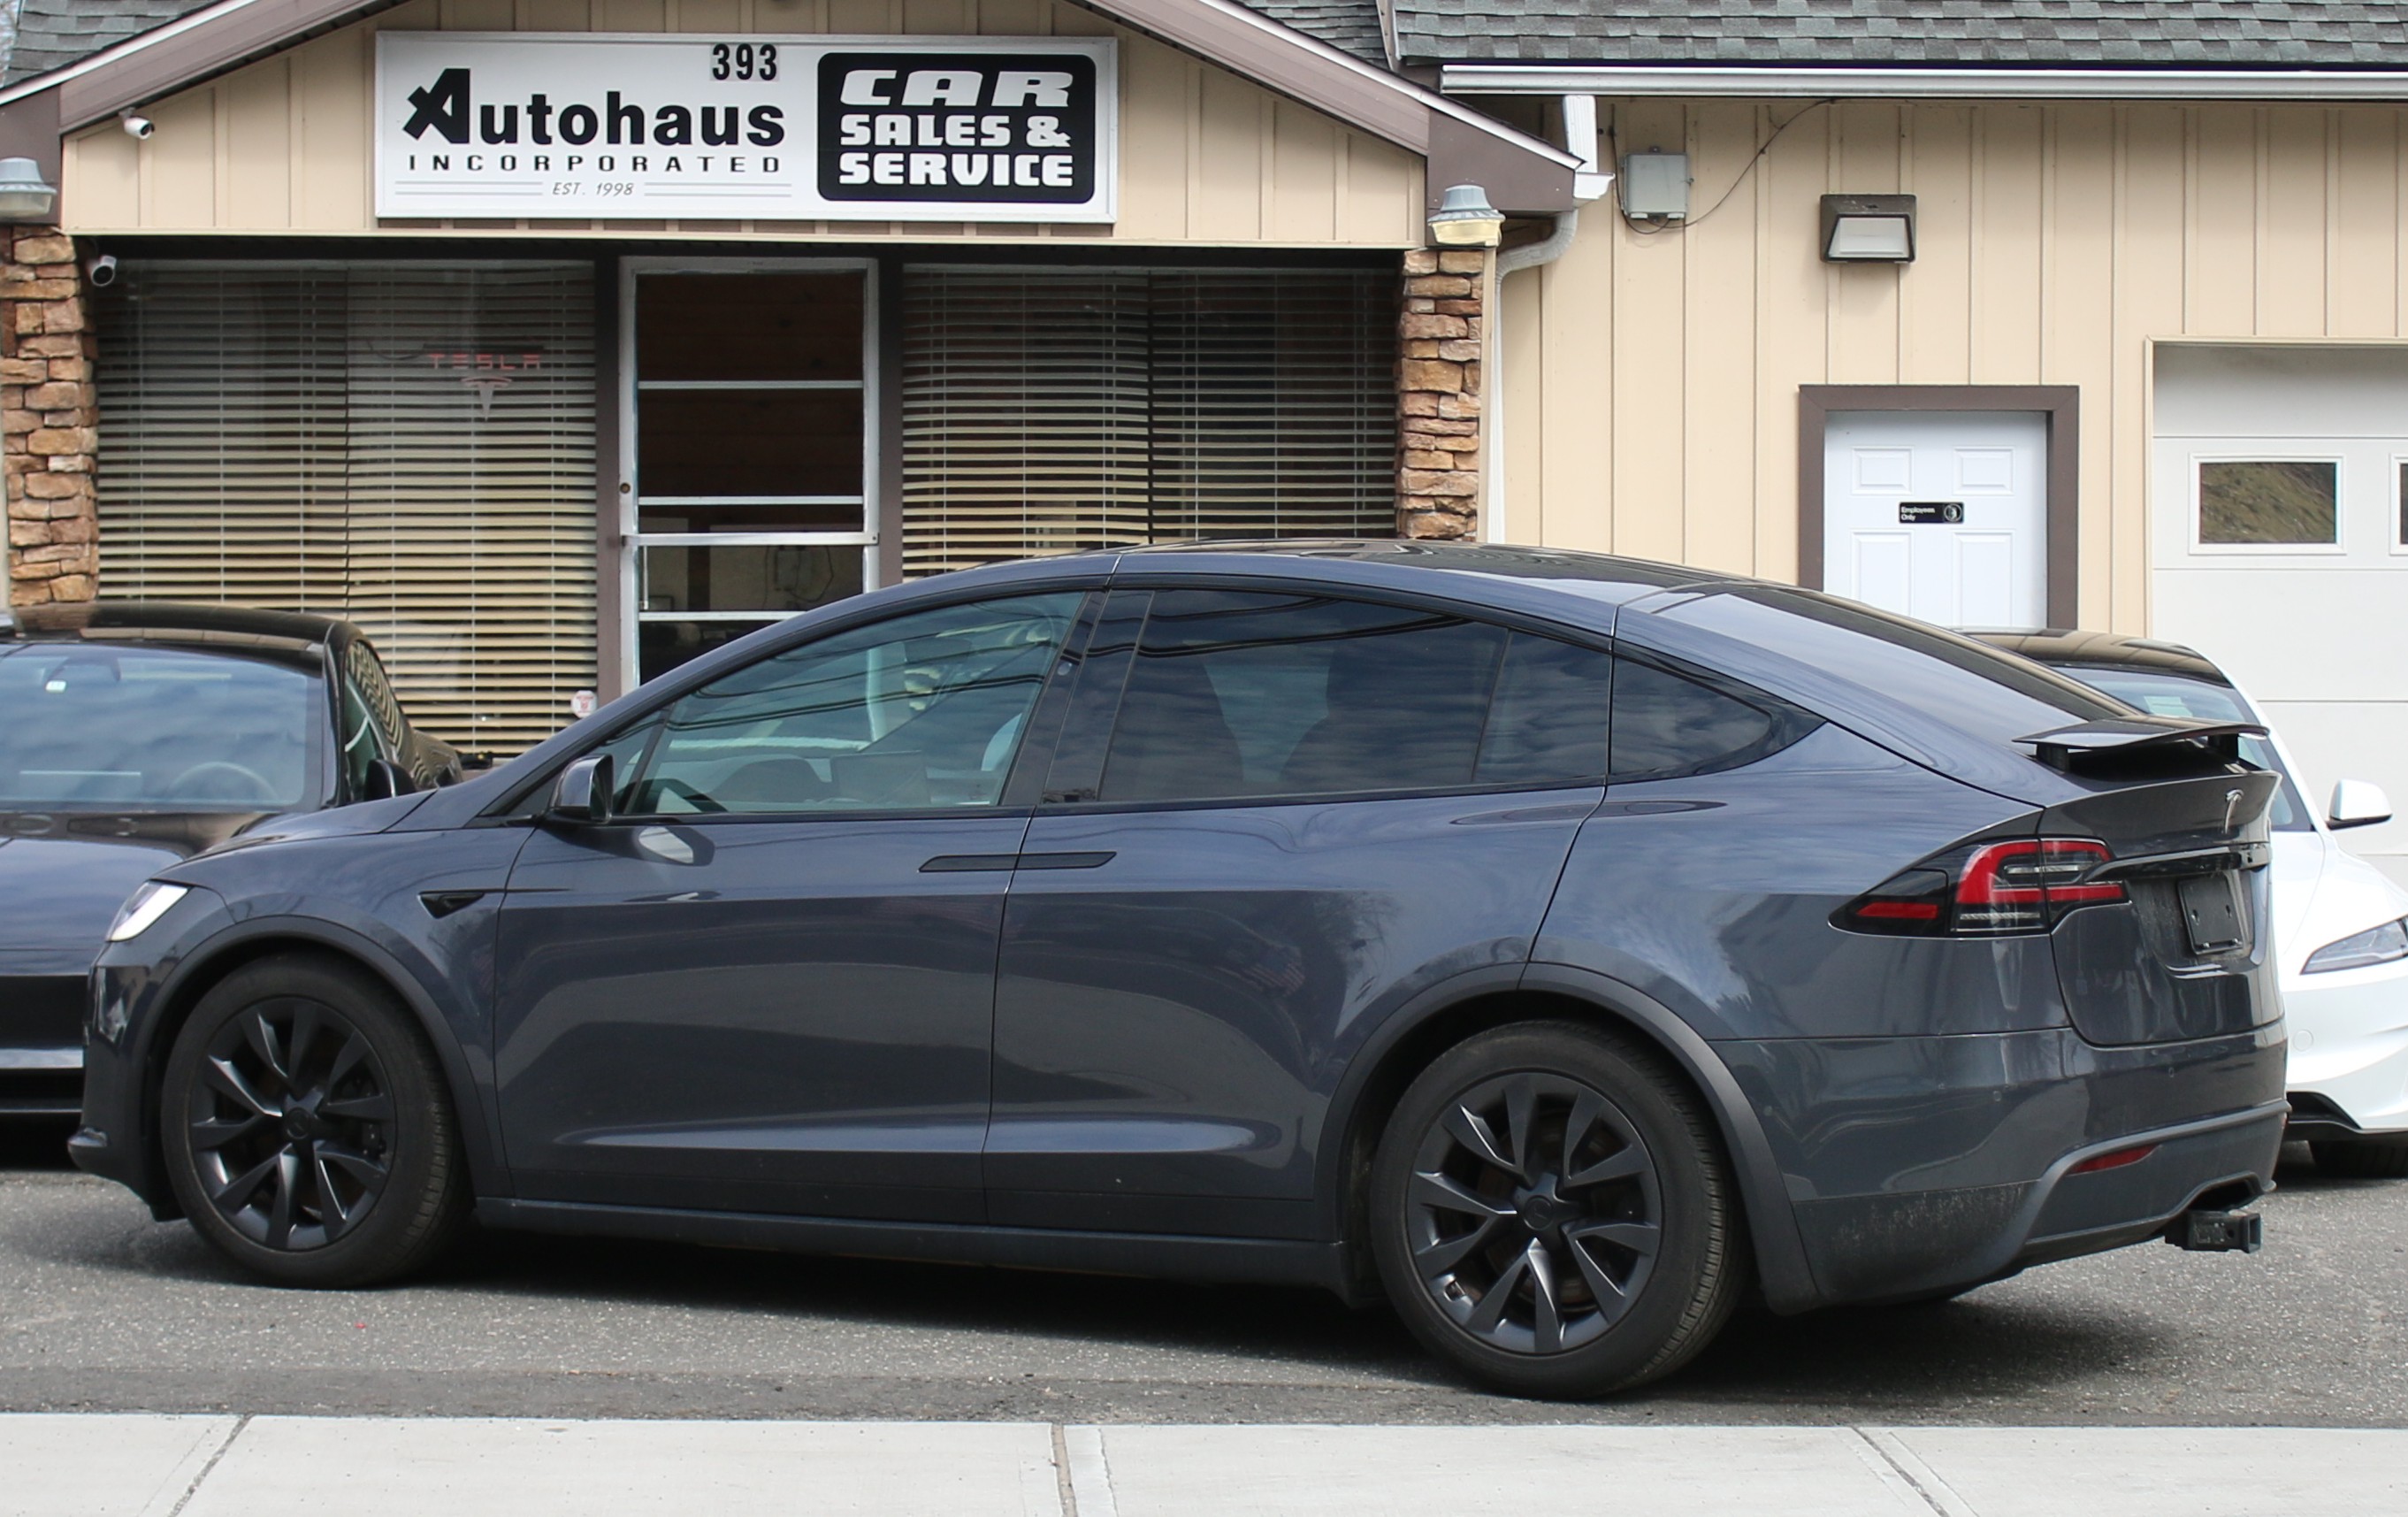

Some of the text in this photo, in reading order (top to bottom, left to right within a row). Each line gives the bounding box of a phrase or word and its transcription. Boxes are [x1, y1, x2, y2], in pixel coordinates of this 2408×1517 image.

[712, 43, 777, 80] 393
[840, 69, 1074, 107] CAR
[402, 67, 785, 146] Autohaus
[840, 114, 1072, 147] SALES &
[409, 154, 780, 172] INCORPORATED
[839, 152, 1073, 187] SERVICE
[552, 181, 634, 196] EST. 1998
[428, 353, 540, 370] TESLA
